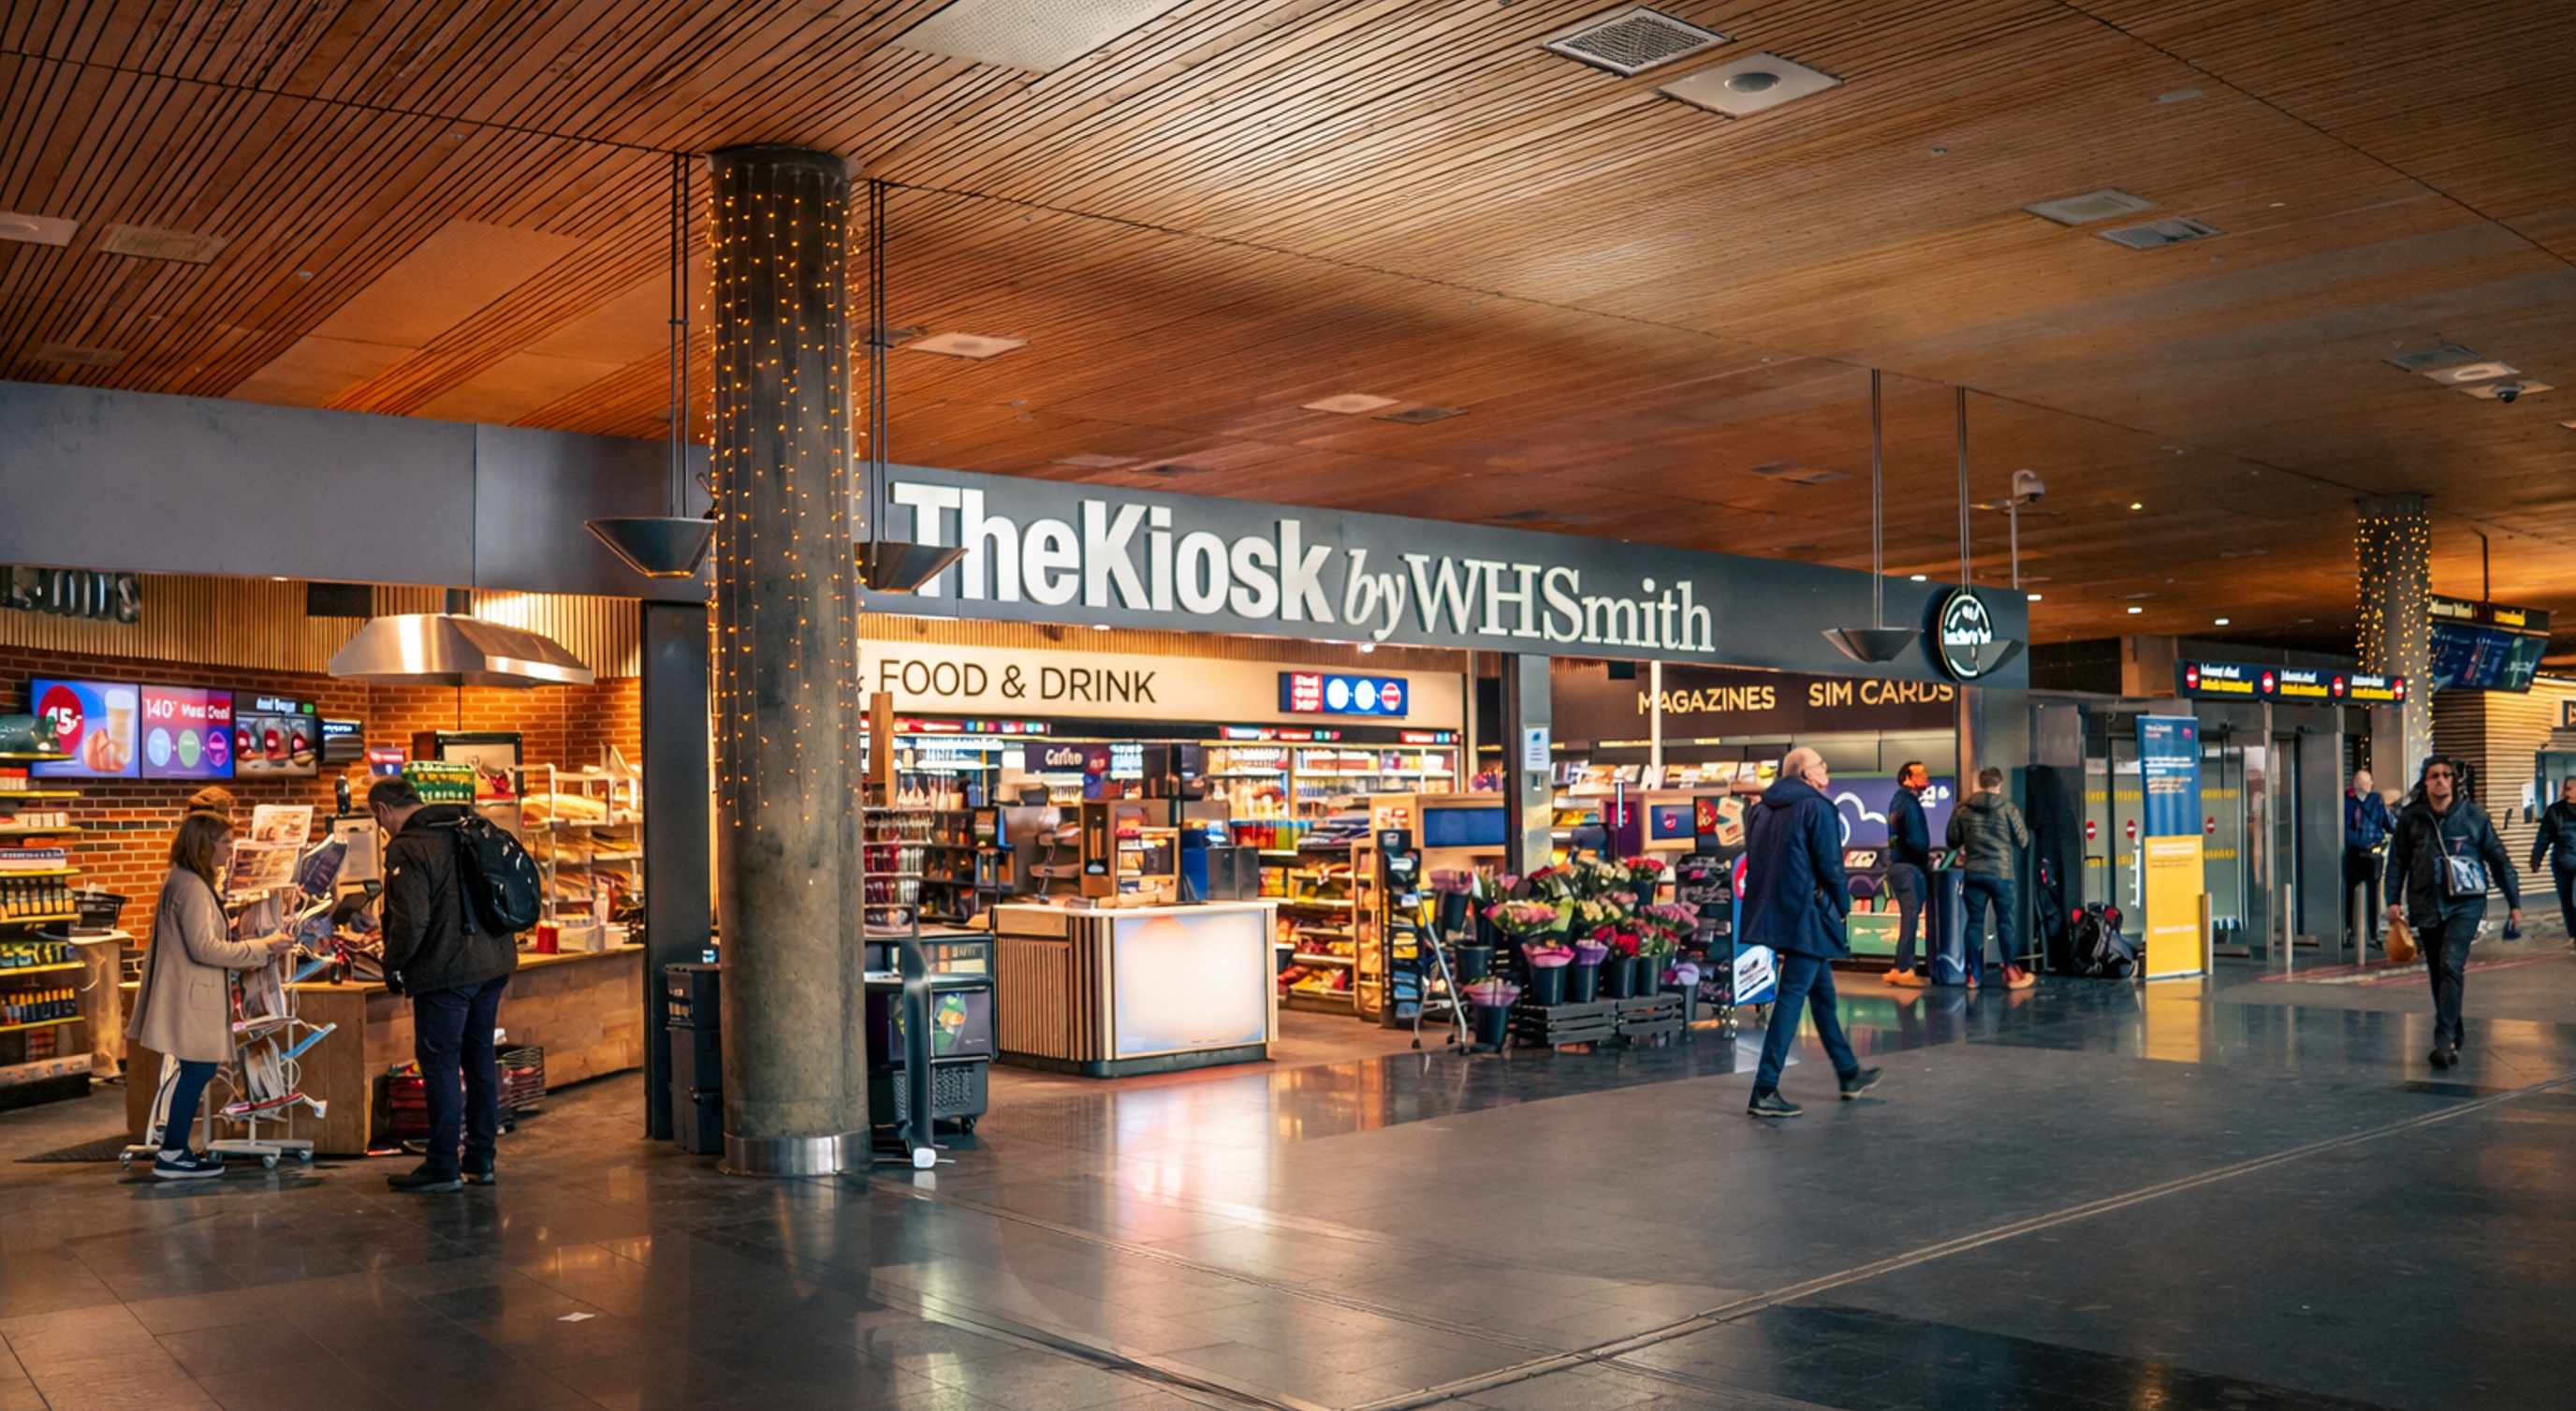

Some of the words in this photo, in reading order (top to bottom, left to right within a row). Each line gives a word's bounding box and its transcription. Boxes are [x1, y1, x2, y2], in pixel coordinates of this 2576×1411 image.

[891, 480, 1336, 624] TheKiosk
[1344, 548, 1405, 643] by
[1403, 552, 1716, 654] WHSmith
[880, 659, 988, 698] FOOD
[1001, 664, 1027, 699] &
[1040, 667, 1158, 704] DRINK
[1638, 685, 1777, 715] MAGAZINES
[1808, 681, 1852, 708] SIM
[1859, 679, 1955, 705] CARDS
